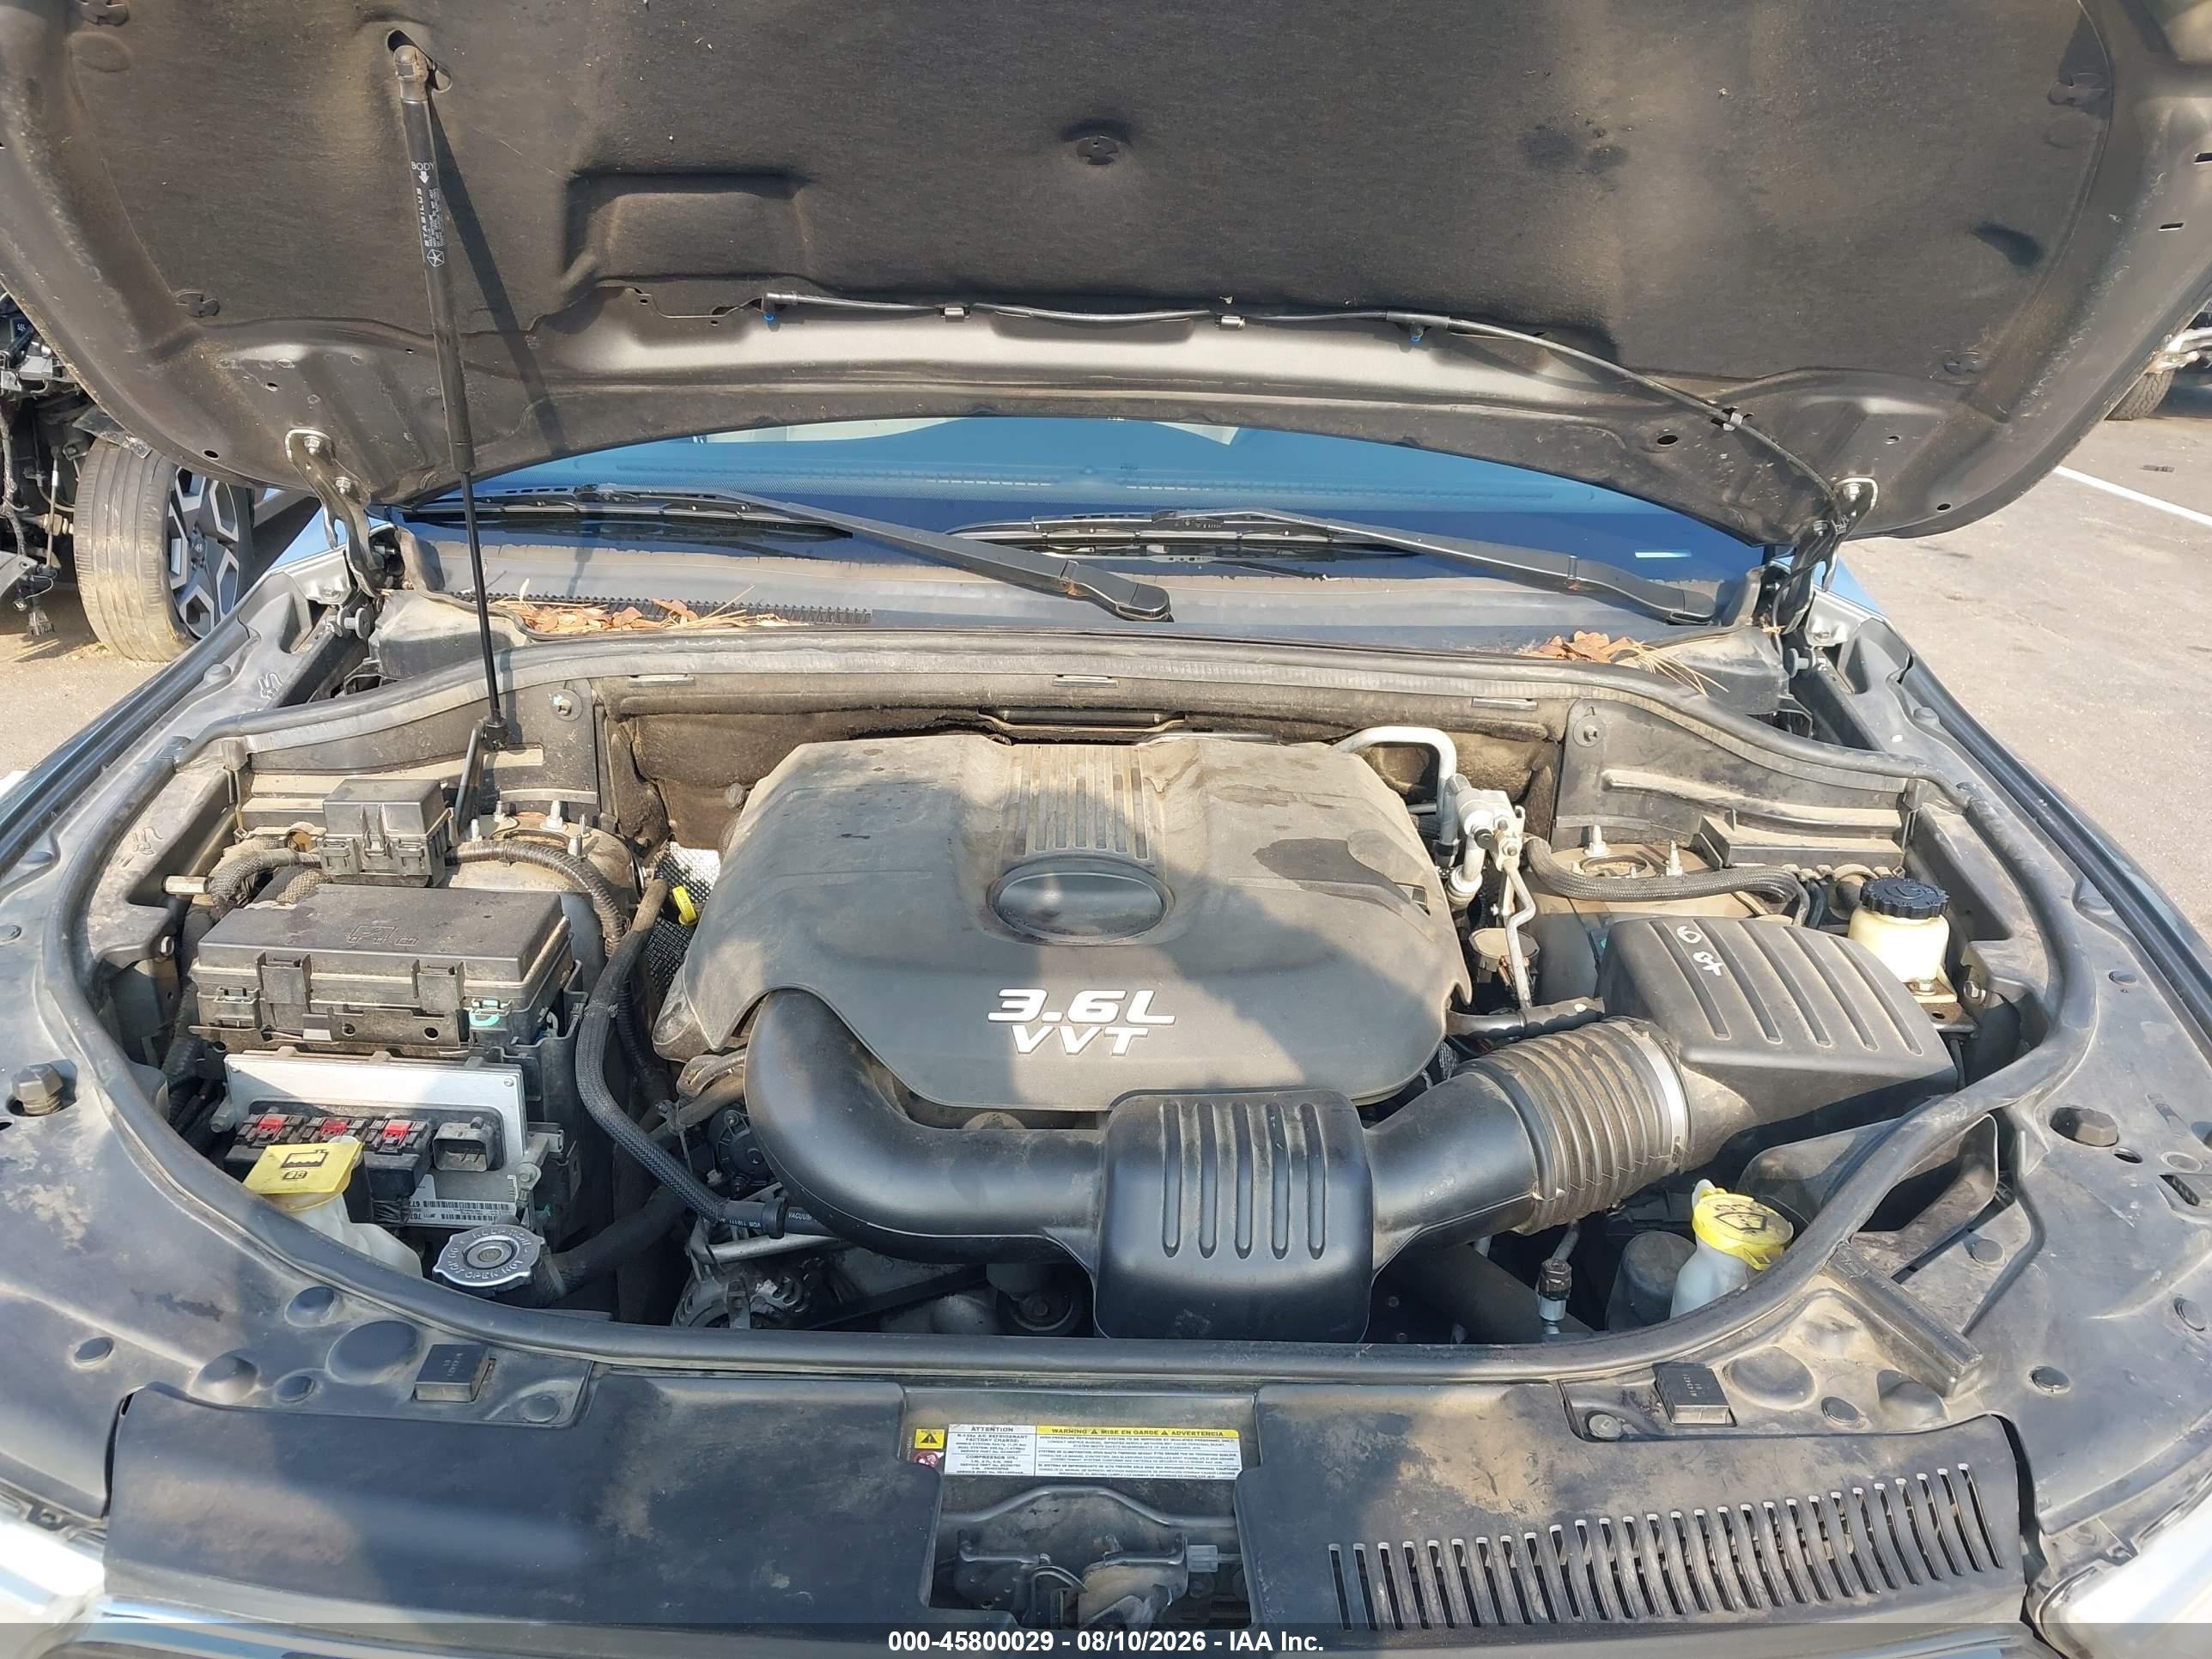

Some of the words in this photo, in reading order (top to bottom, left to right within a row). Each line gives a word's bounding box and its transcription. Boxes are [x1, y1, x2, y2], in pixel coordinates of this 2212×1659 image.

[411, 161, 434, 171] BODY
[416, 187, 429, 247] STABILUS
[988, 988, 1176, 1024] 3.6L
[1012, 1024, 1149, 1056] VVT
[788, 1211, 812, 1221] VACUUM
